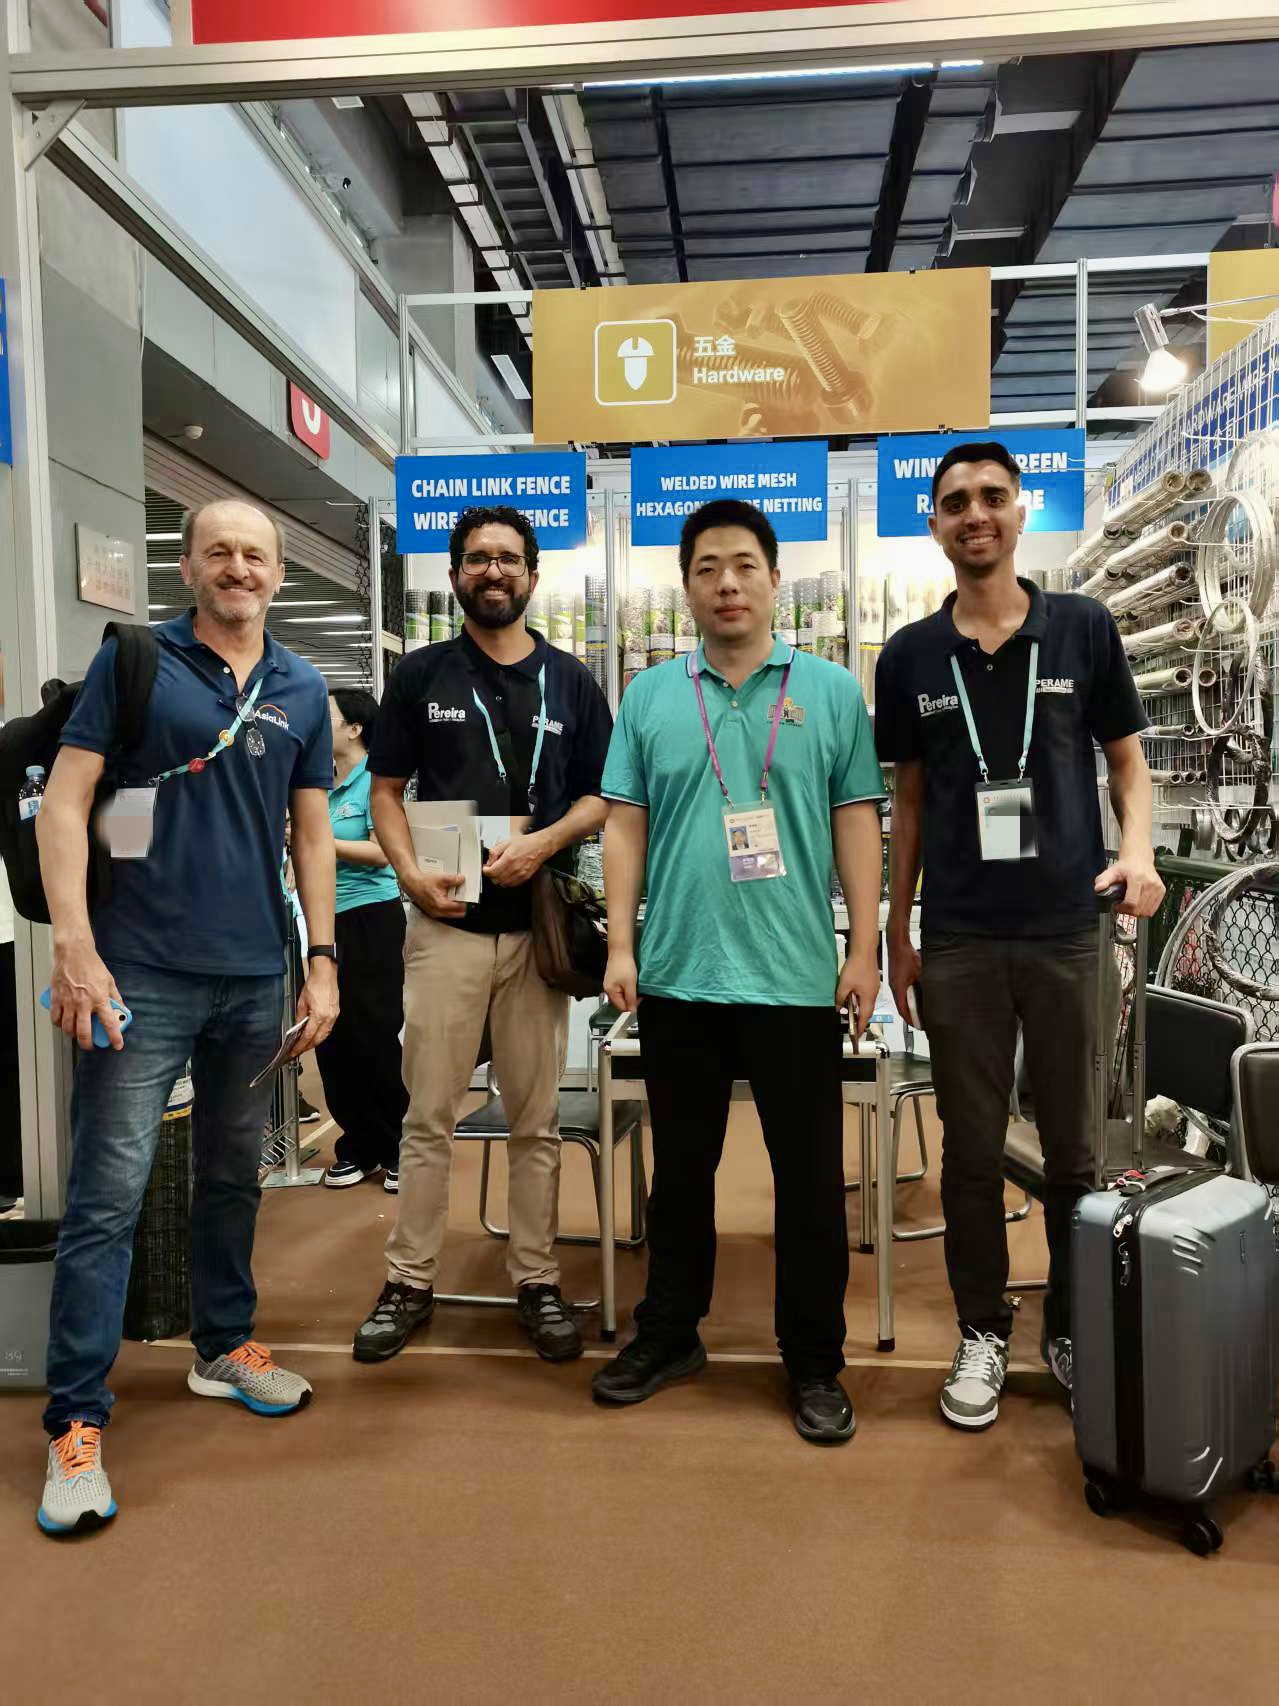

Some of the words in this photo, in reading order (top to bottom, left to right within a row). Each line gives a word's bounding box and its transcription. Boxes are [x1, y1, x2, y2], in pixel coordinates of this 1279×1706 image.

[694, 335, 736, 356] 五金
[693, 367, 785, 384] Hardware
[1009, 451, 1068, 473] REEN
[411, 478, 468, 498] CHAIN
[471, 477, 513, 496] LINK
[516, 475, 571, 495] FENCE
[660, 475, 717, 491] WELDED
[719, 474, 755, 489] WIRE
[757, 472, 797, 488] MESH
[763, 497, 822, 513] NETTING
[1034, 678, 1075, 688] PERAME
[428, 702, 466, 719] Pereira
[917, 693, 959, 713] Pereira
[255, 709, 290, 731] AsiaLink
[532, 715, 564, 731] PRAME
